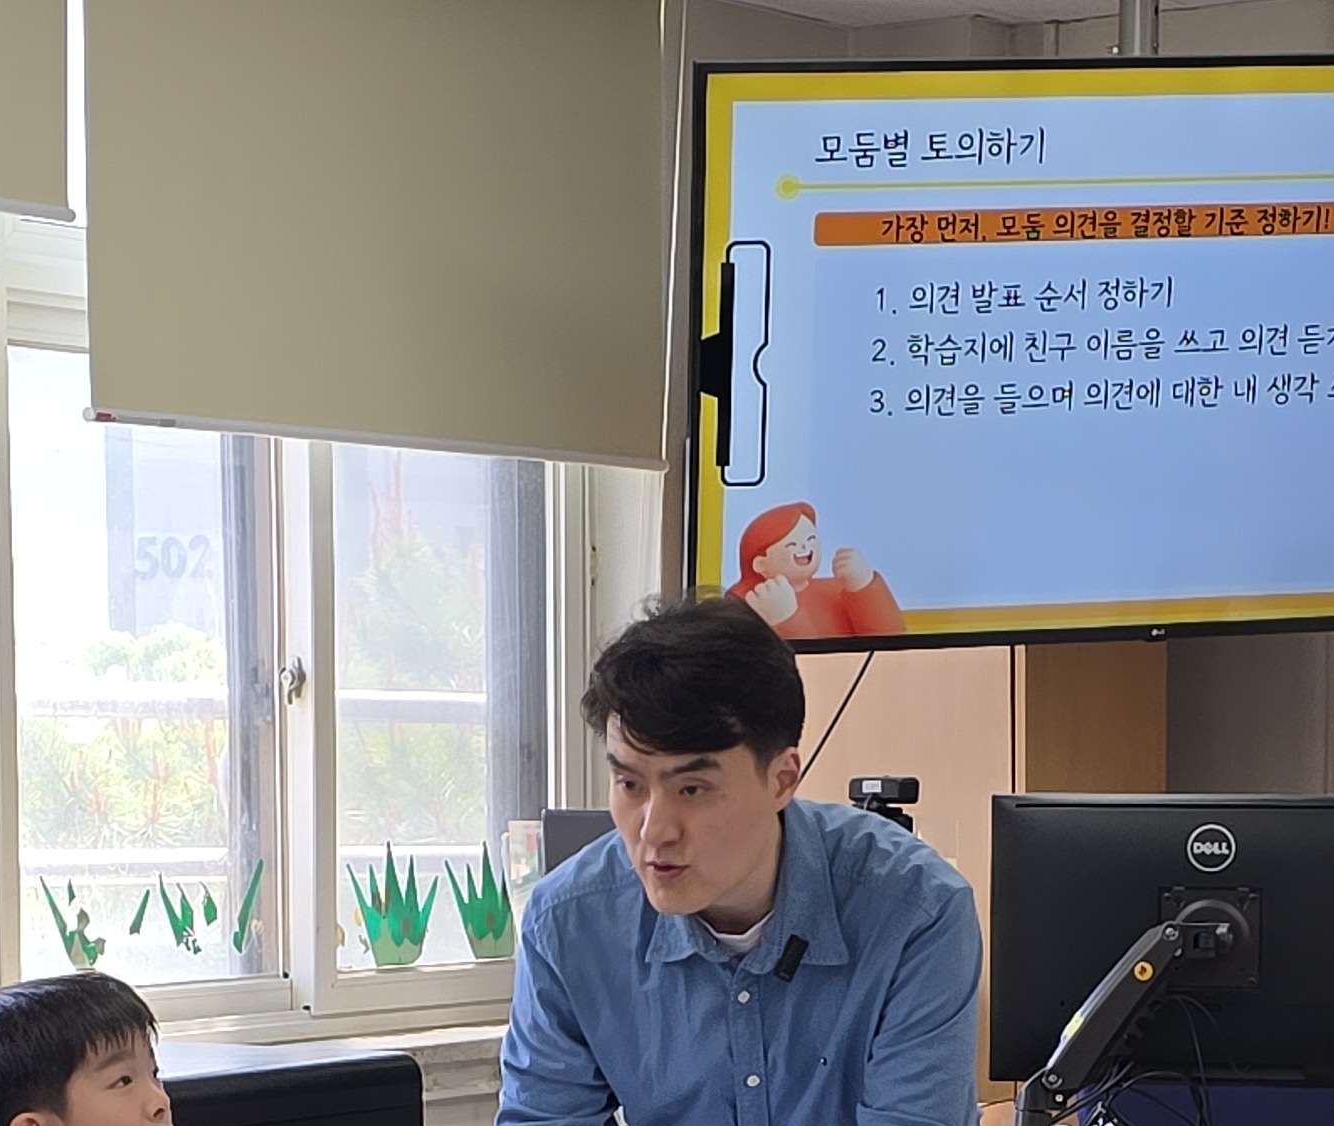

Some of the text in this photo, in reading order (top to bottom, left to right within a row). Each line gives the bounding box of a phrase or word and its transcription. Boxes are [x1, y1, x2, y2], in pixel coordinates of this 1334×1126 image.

[814, 127, 1046, 168] 모둠별 토의하기
[880, 205, 1330, 243] 가장 먼저, 모둠 의견을 결정할 기준 정하기!
[876, 276, 1174, 315] 1. 의견 발표 순서 정하기
[871, 338, 895, 367] 2.
[906, 331, 1014, 366] 학습지에
[1025, 330, 1077, 362] 친구
[1086, 328, 1165, 360] 이름을
[1174, 328, 1229, 353] 쓰고
[1238, 323, 1289, 355] 의견
[870, 389, 893, 416] 3.
[905, 383, 985, 416] 의견을
[994, 380, 1073, 414] 들으며
[1084, 377, 1160, 410] 의견에
[1172, 375, 1223, 408] 대한
[1234, 374, 1256, 405] 내
[1267, 372, 1320, 405] 생각
[135, 535, 214, 580] 502
[1193, 842, 1229, 855] DELL
